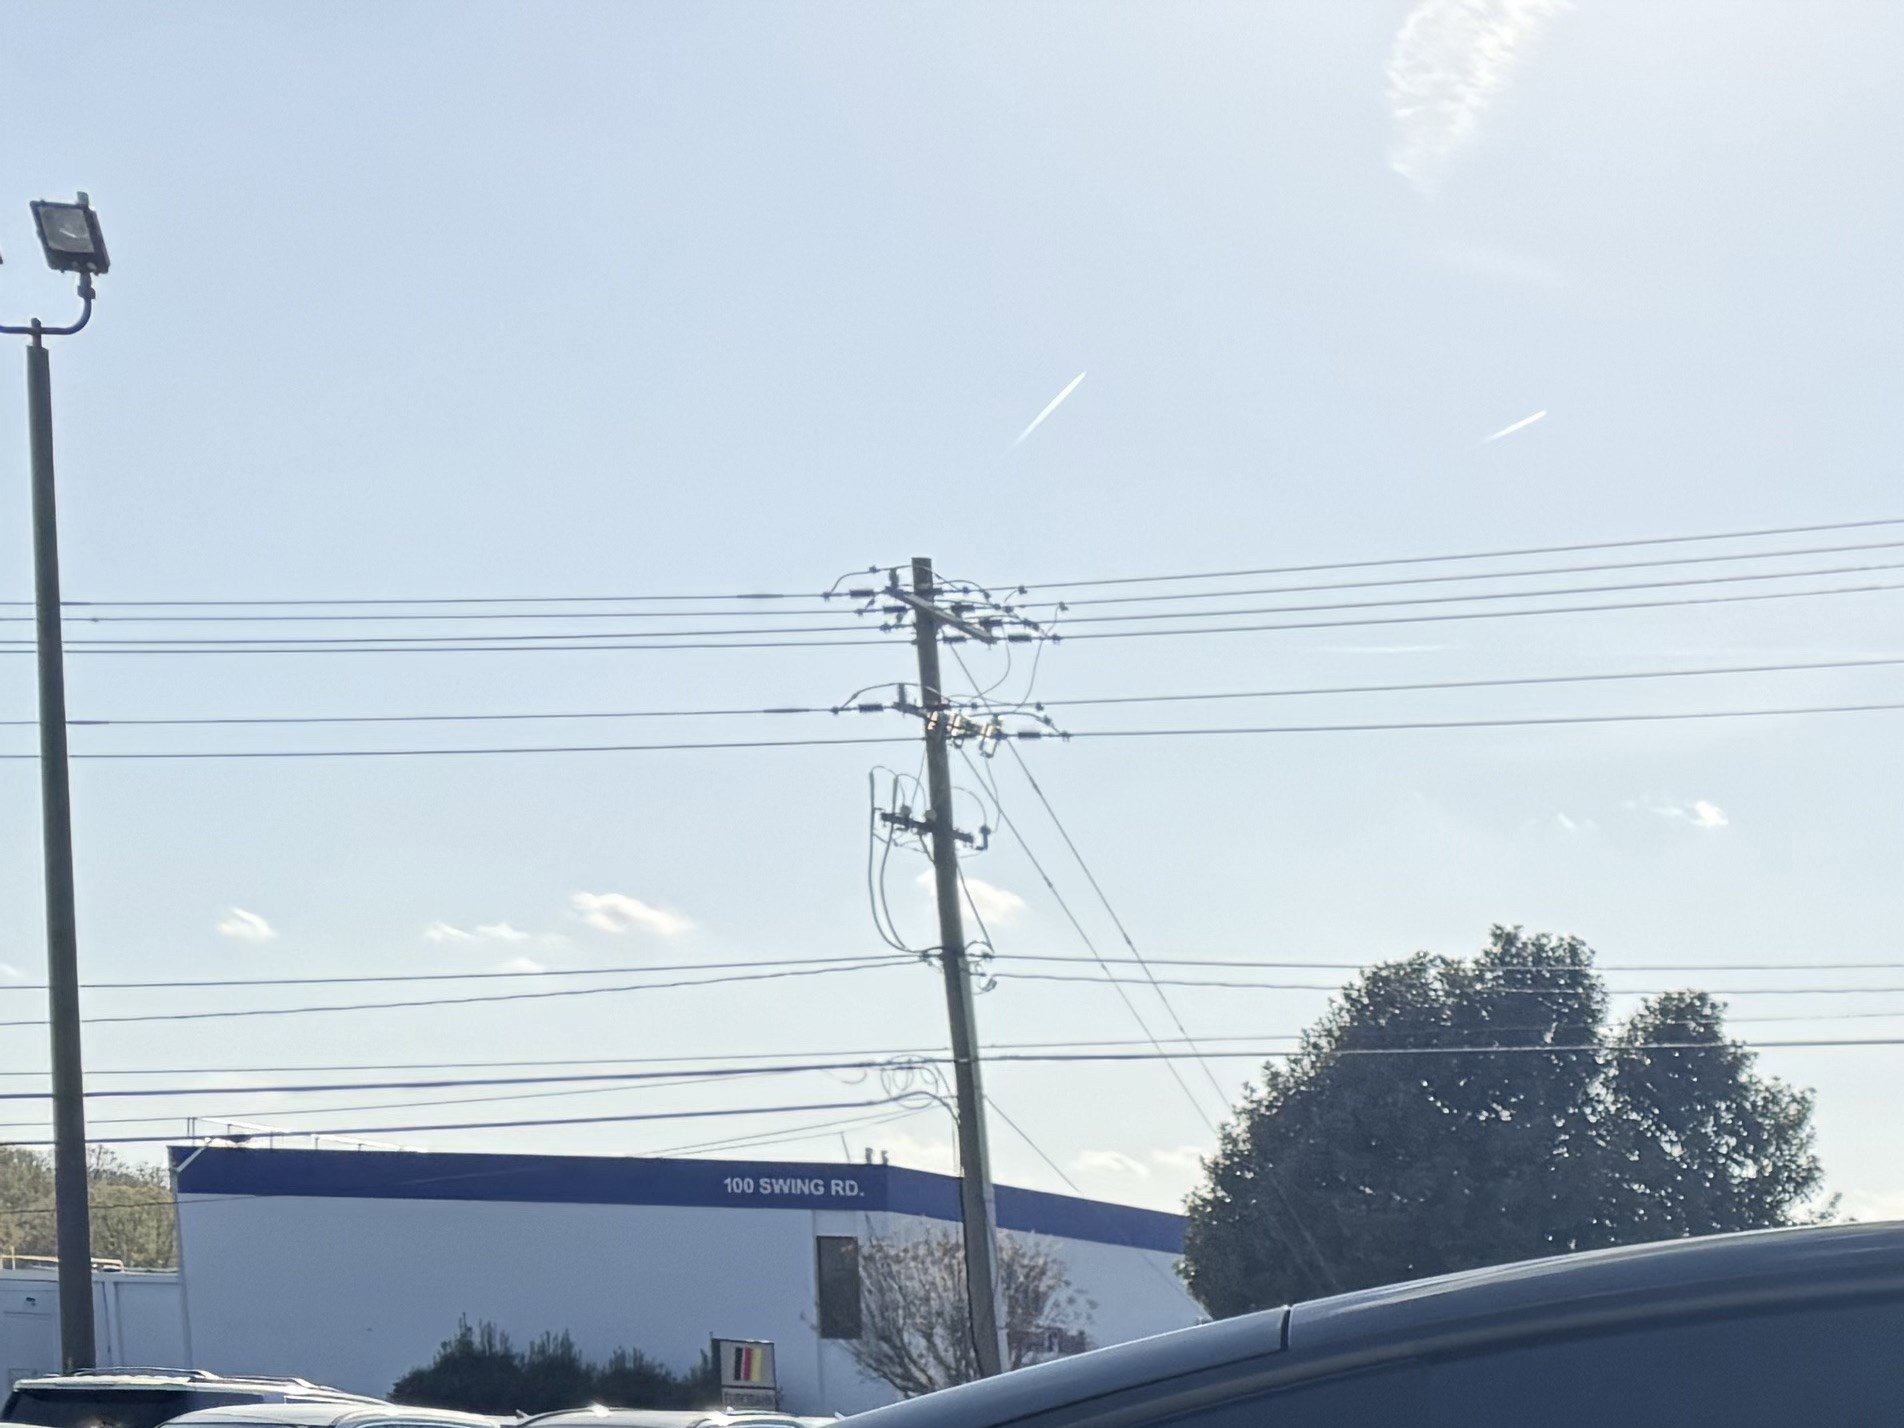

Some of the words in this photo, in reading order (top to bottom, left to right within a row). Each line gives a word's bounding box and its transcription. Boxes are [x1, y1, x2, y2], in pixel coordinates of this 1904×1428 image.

[723, 1177, 754, 1193] 100
[759, 1178, 825, 1195] SWING
[830, 1179, 865, 1196] RD.
